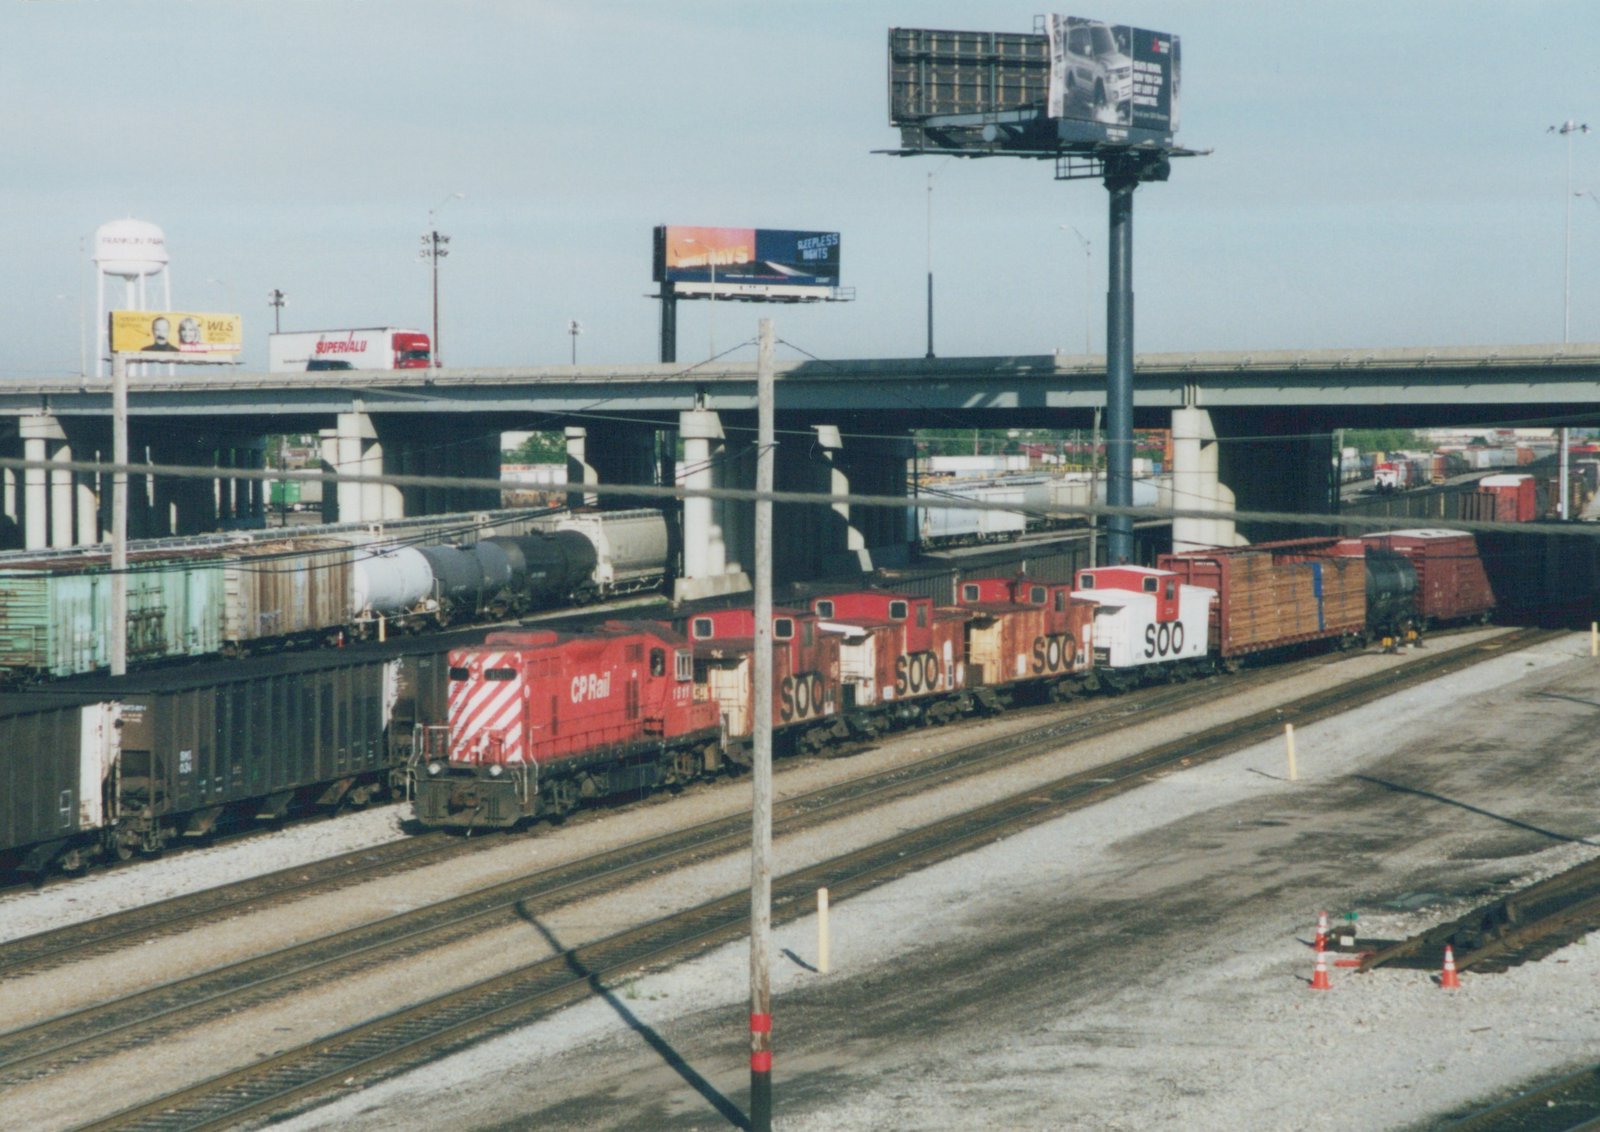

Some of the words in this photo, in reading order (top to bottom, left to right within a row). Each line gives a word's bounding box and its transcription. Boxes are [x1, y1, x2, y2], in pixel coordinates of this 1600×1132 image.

[207, 320, 234, 331] WLS
[315, 329, 368, 354] SUPERVALU
[1032, 632, 1076, 674] SOO
[1145, 621, 1184, 658] SOO
[587, 670, 612, 701] Rail
[895, 650, 939, 696] SOO
[780, 671, 825, 721] SOO
